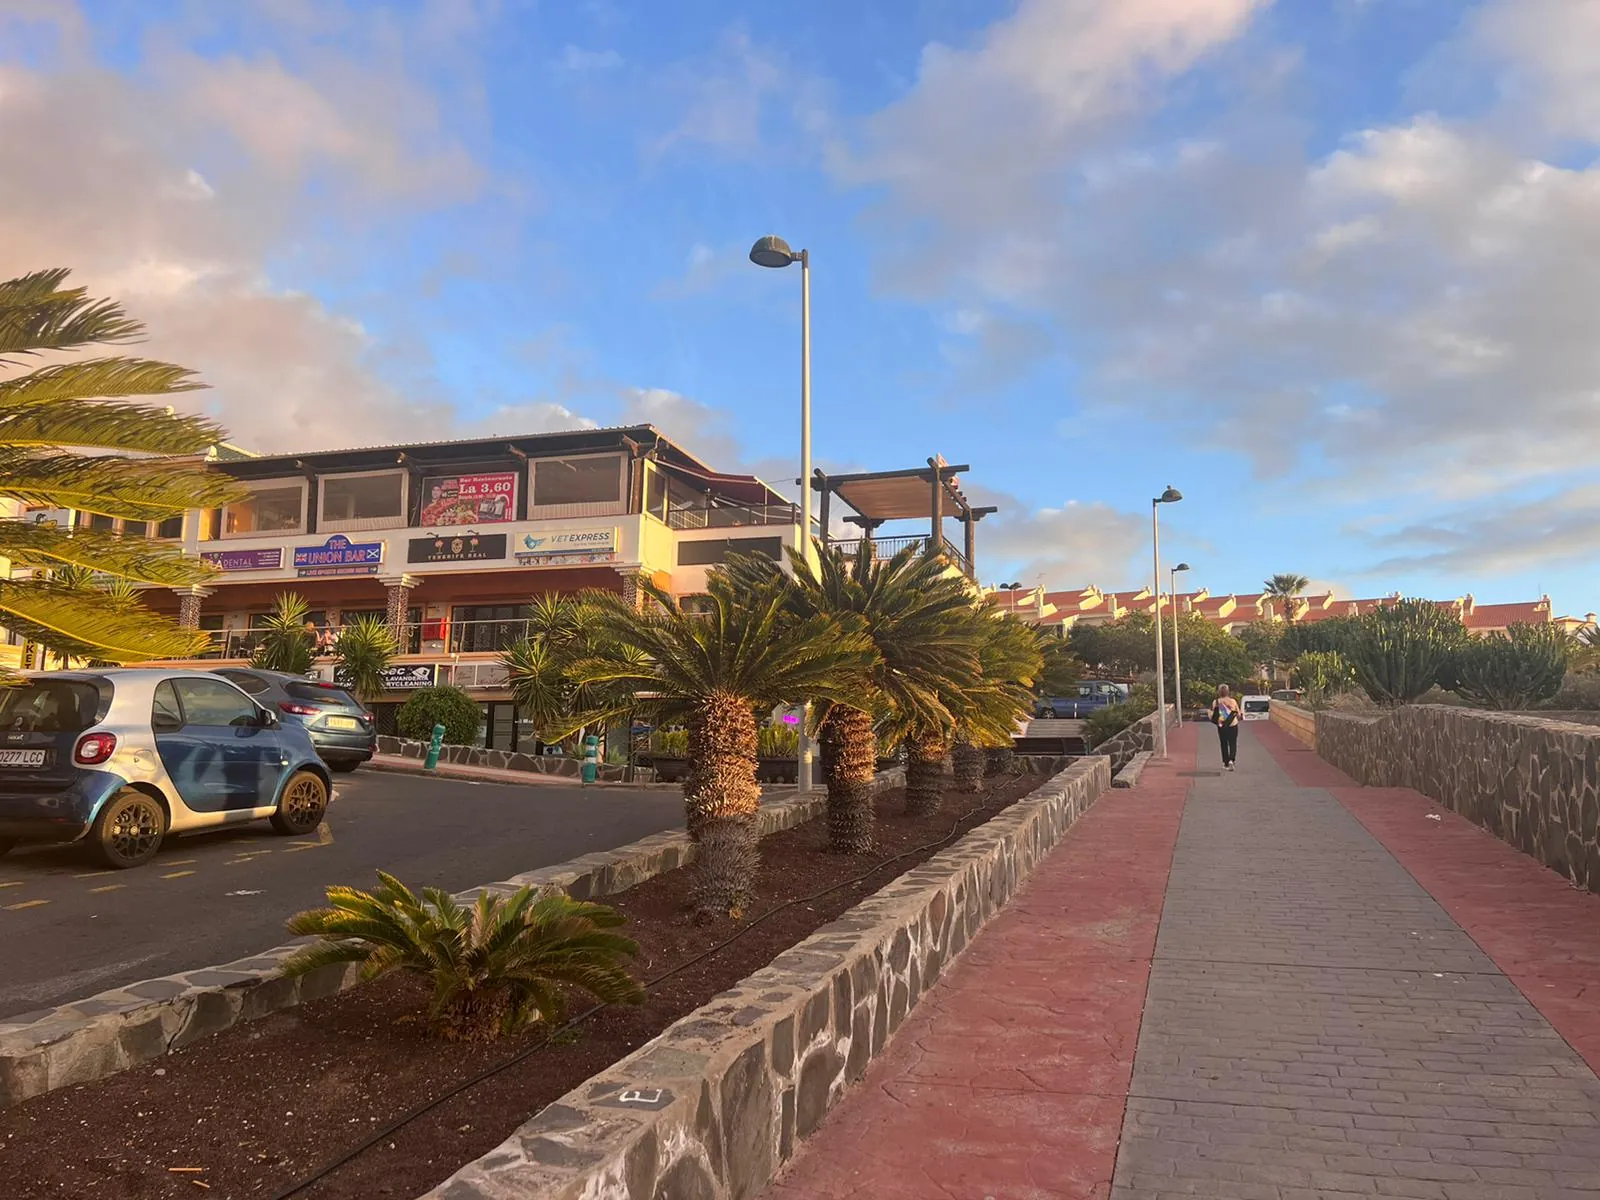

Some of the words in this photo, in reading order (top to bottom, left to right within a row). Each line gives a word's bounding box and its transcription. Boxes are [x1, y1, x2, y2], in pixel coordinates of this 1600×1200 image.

[459, 484, 476, 494] La
[481, 482, 511, 493] 3.60
[329, 540, 347, 550] THE
[223, 558, 252, 567] DENTAL
[308, 551, 342, 564] UNION
[345, 550, 366, 562] BAR
